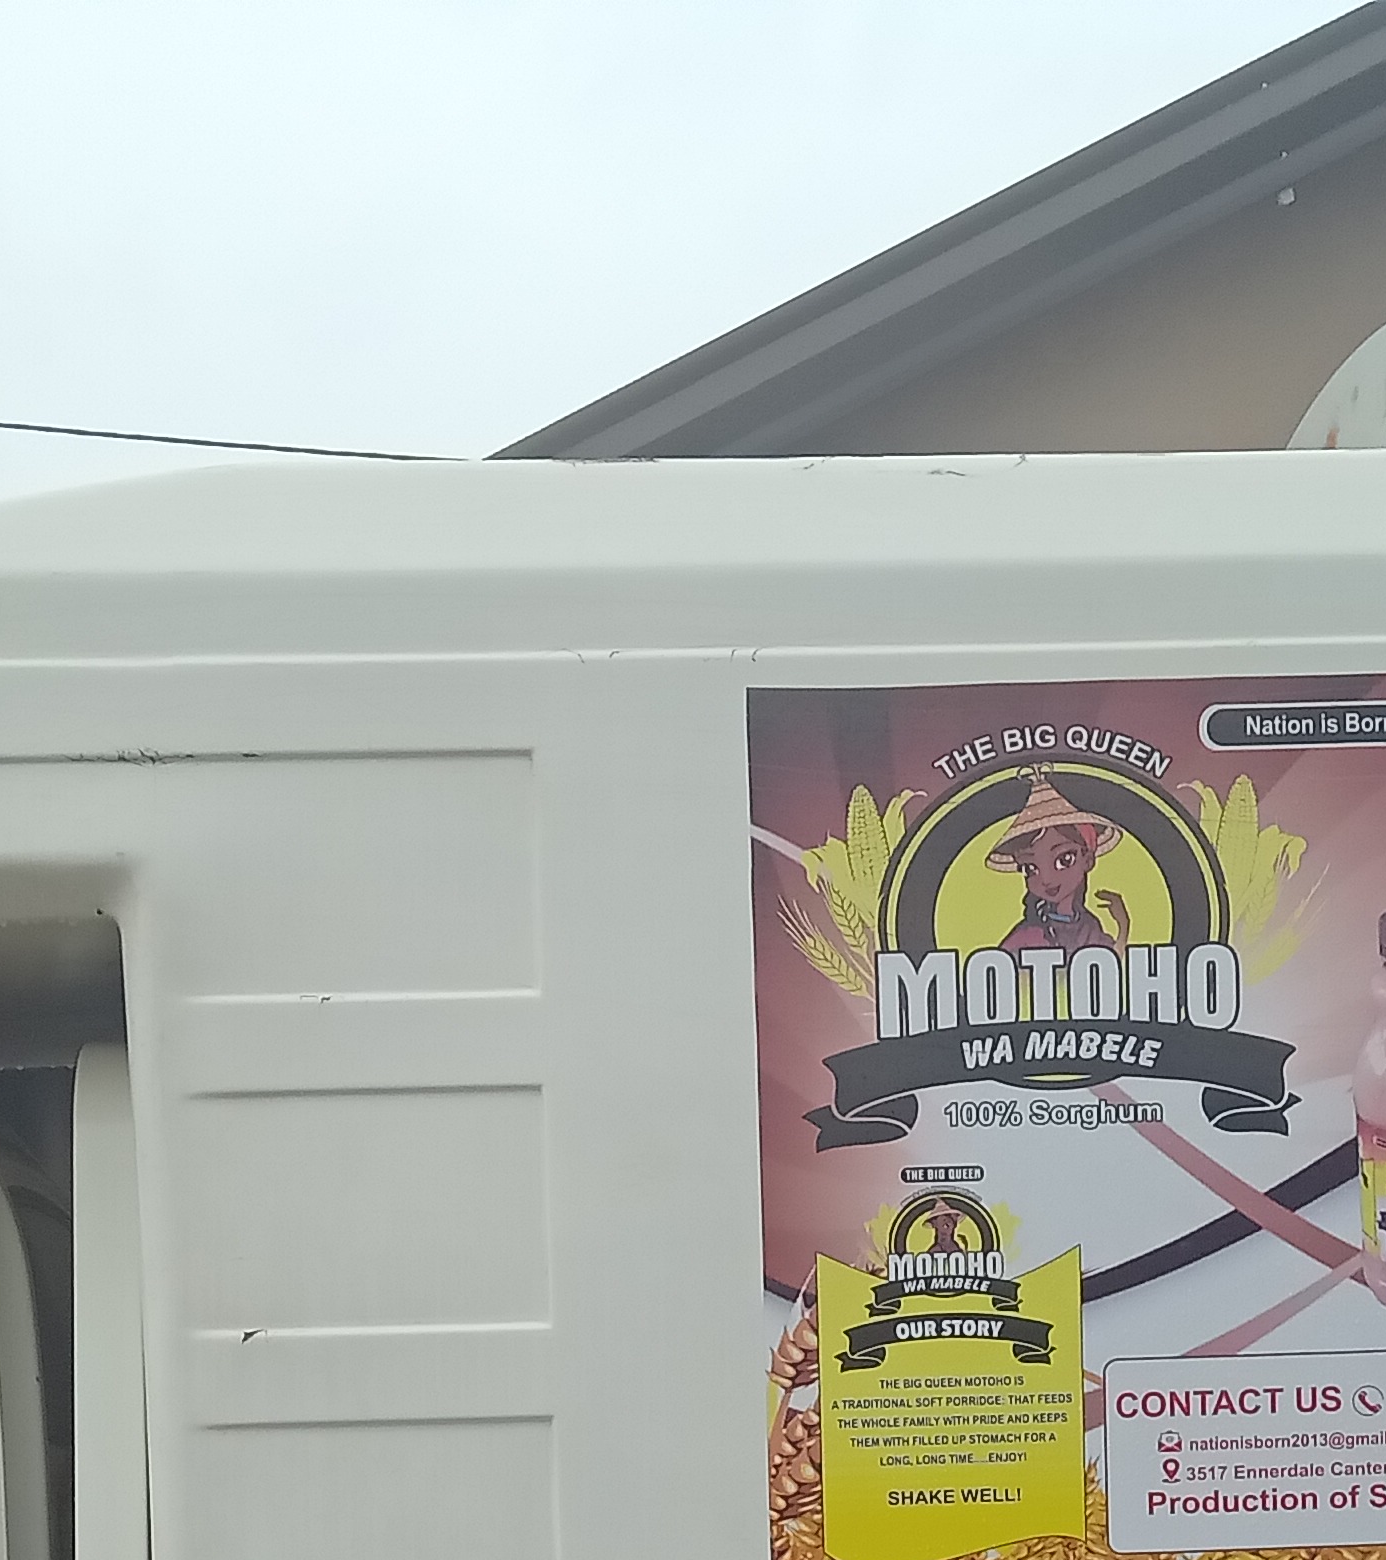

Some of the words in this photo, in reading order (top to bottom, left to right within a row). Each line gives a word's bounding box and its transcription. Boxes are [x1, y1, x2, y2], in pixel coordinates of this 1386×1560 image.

[1246, 714, 1314, 736] Nation
[1319, 713, 1339, 735] is
[933, 734, 998, 781] THE
[1002, 725, 1057, 753] BIG
[1065, 725, 1173, 780] QUEEN
[875, 943, 1241, 1040] MOTOHO
[962, 1036, 1014, 1070] WA
[1024, 1030, 1163, 1068] MABELE
[944, 1101, 1022, 1128] 100%
[1029, 1099, 1164, 1129] Sorghum
[905, 1169, 925, 1181] THE
[948, 1167, 982, 1181] QUEEN
[888, 1251, 1004, 1282] MOTOHO
[903, 1281, 926, 1293] WA
[930, 1278, 991, 1293] MABELE
[895, 1321, 938, 1339] OUR
[941, 1319, 1004, 1338] STORY
[879, 1379, 900, 1389] THE
[903, 1378, 922, 1389] BIG
[925, 1377, 962, 1388] QUEEN
[964, 1376, 1011, 1387] MOTOHO
[1014, 1375, 1024, 1386] IS
[831, 1400, 839, 1410] A
[842, 1398, 913, 1410] TRADITIONAL
[916, 1396, 944, 1408] SOFT
[1007, 1394, 1035, 1406] THAT
[1037, 1393, 1073, 1404] FEEDS
[1115, 1387, 1285, 1419] CONTACT
[1295, 1386, 1343, 1414] US
[837, 1418, 858, 1429] THE
[861, 1417, 900, 1429] WHOLE
[903, 1416, 940, 1428] FAMILY
[943, 1415, 970, 1426] WITH
[972, 1413, 1004, 1425] PRIDE
[1007, 1413, 1030, 1424] AND
[1032, 1412, 1068, 1423] KEEPS
[850, 1437, 880, 1448] THEM
[882, 1436, 910, 1447] WITH
[912, 1435, 949, 1446] FILLED
[951, 1434, 966, 1445] UP
[968, 1433, 1021, 1445] STOMACH
[1024, 1432, 1046, 1443] FOR
[1048, 1431, 1056, 1442] A
[879, 1455, 914, 1467] LONG,
[916, 1454, 946, 1465] LONG
[1186, 1465, 1227, 1481] 3517
[1234, 1461, 1324, 1480] Ennerdale
[887, 1489, 955, 1506] SHAKE
[961, 1488, 1022, 1504] WELL!
[1147, 1487, 1319, 1516] Production
[1329, 1484, 1360, 1509] of
